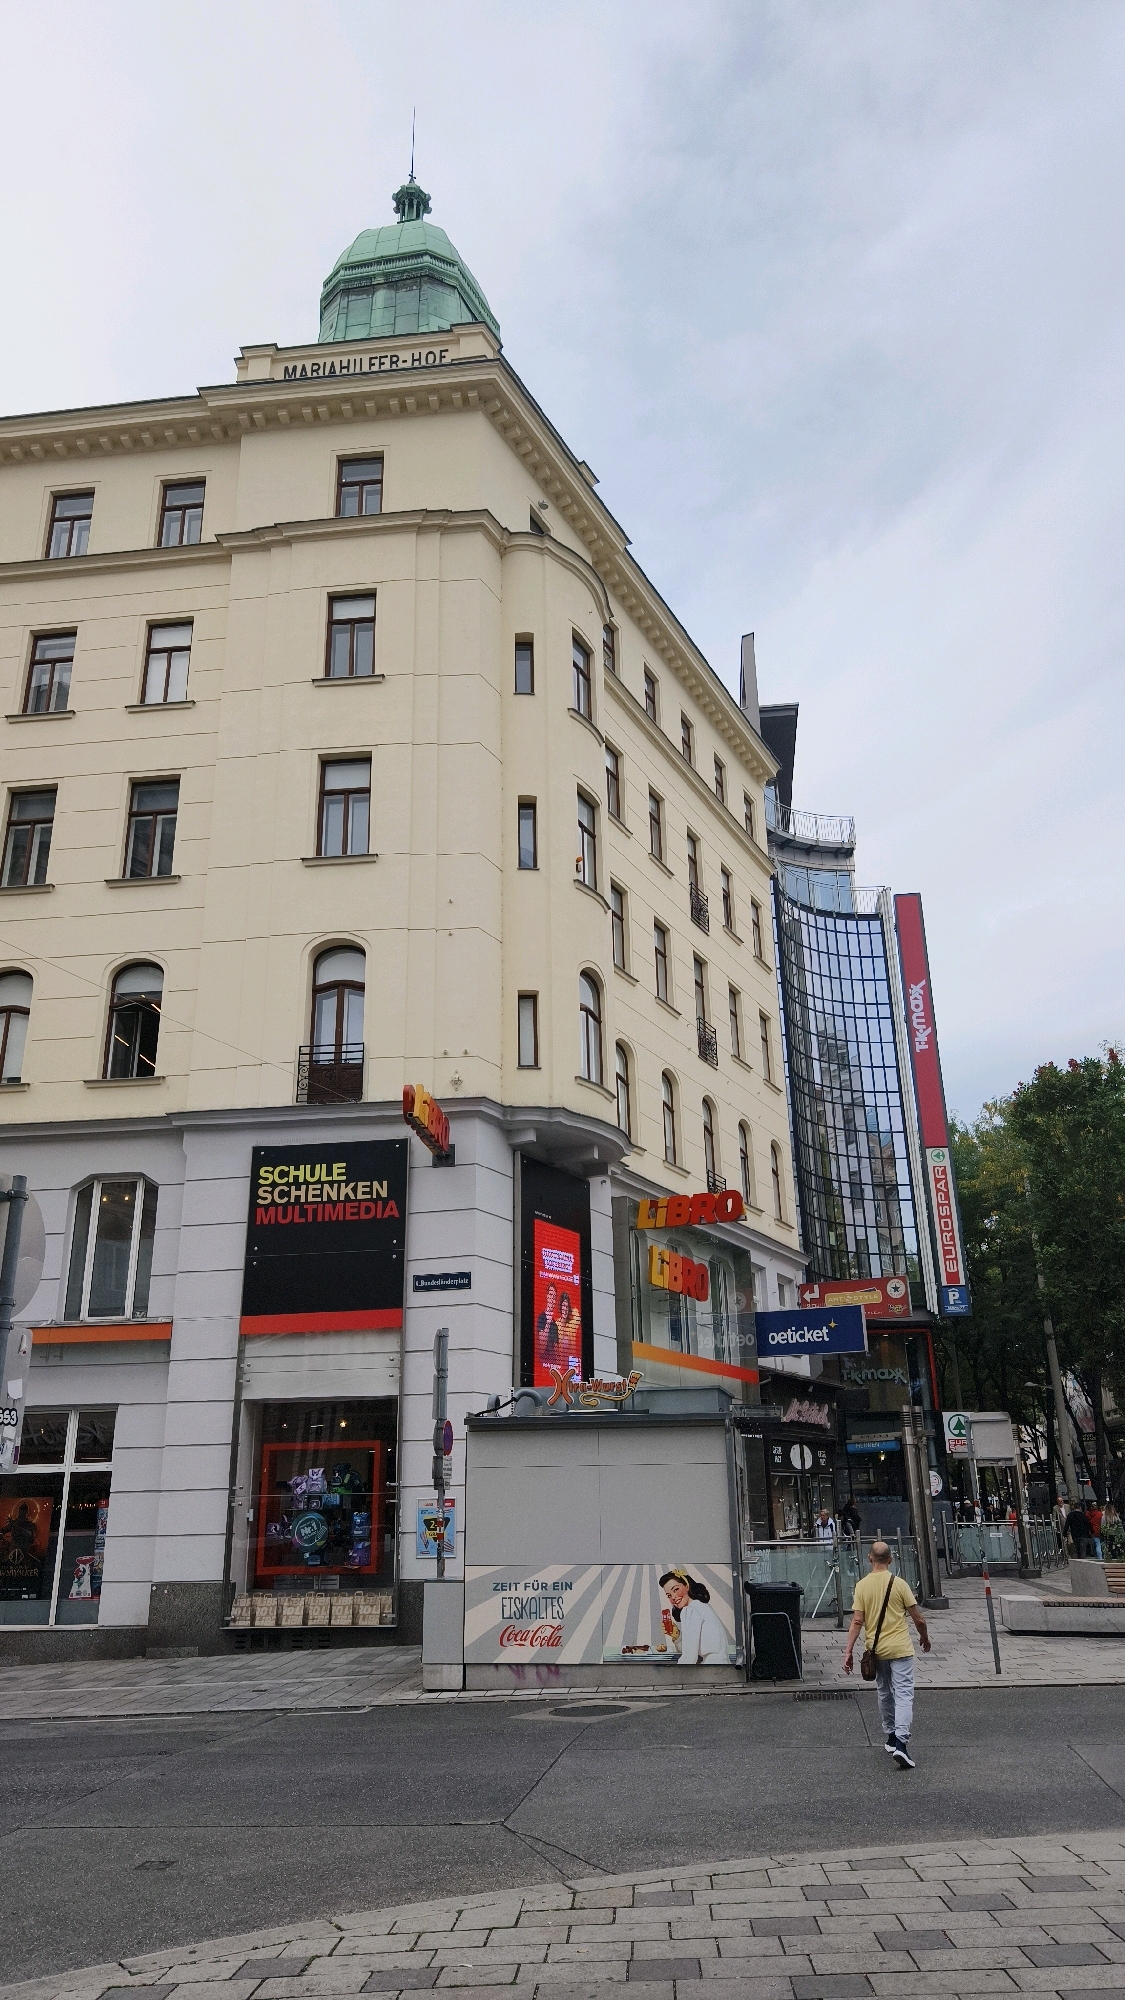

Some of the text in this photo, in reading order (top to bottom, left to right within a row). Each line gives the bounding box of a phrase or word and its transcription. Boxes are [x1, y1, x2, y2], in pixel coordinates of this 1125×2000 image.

[258, 1163, 346, 1184] SCHULE
[256, 1180, 388, 1204] SCHENKEN
[255, 1200, 399, 1225] MULTIMEDIA
[935, 1166, 957, 1273] EUROSPAR
[768, 1326, 830, 1345] oeticket
[493, 1580, 573, 1592] ZEIT FÜR EIN
[501, 1596, 564, 1620] EISKALTES
